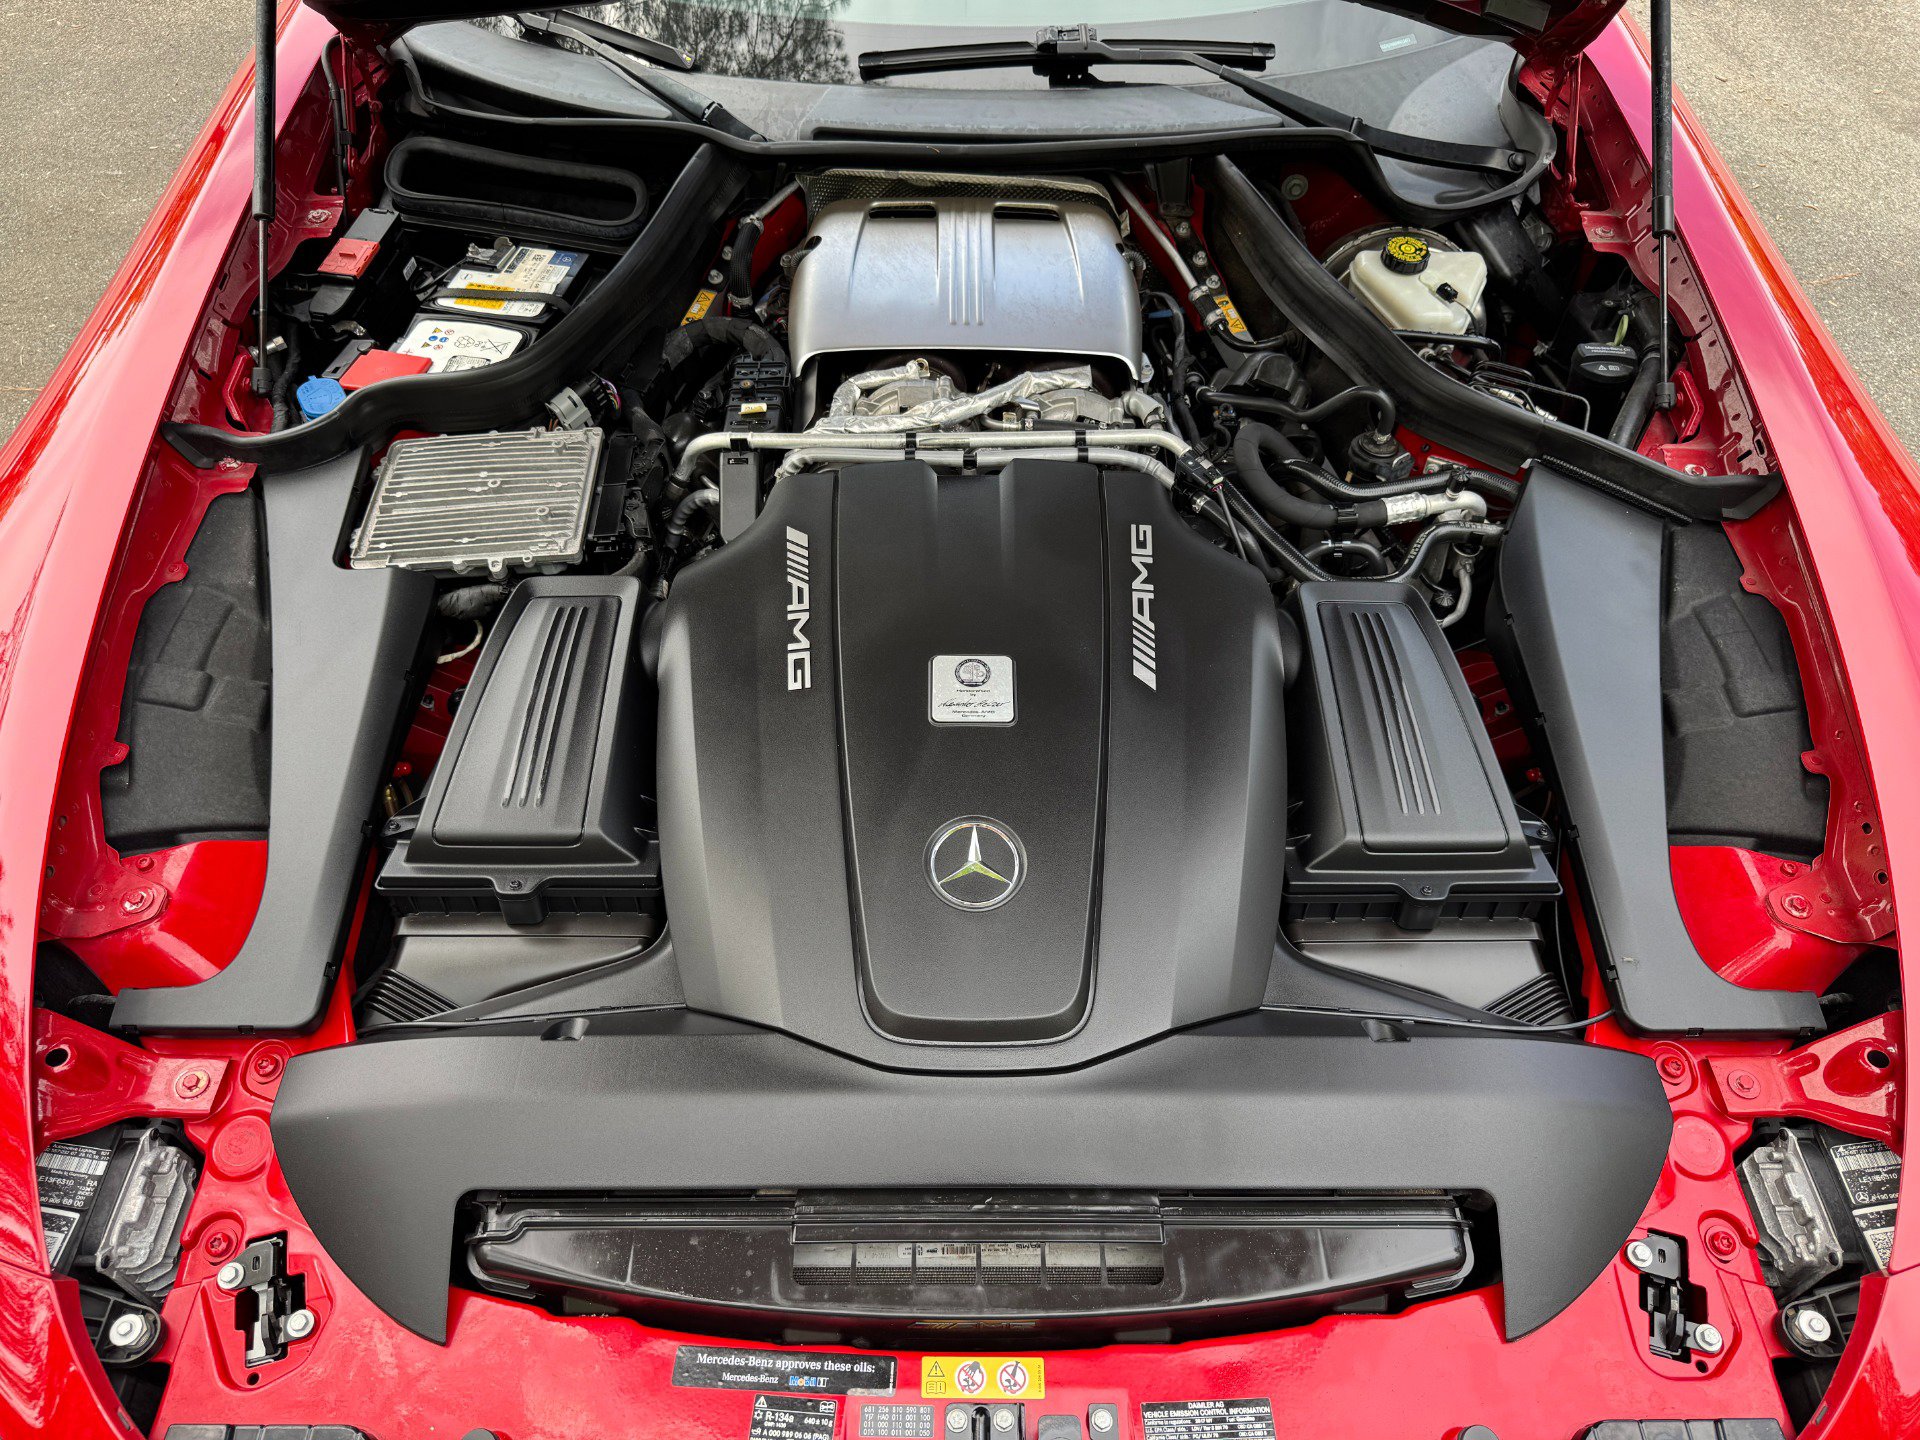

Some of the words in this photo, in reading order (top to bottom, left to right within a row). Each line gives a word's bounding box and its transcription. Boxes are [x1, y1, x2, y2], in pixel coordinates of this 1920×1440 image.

[1131, 524, 1155, 630] AMG
[787, 576, 811, 691] AMG
[697, 1353, 774, 1368] Mercedes-Benz
[775, 1359, 822, 1372] approves
[824, 1358, 852, 1372] these
[853, 1361, 876, 1373] oils:
[722, 1372, 779, 1384] Mercedes-Benz
[789, 1376, 817, 1387] Mobil
[766, 1411, 795, 1423] R-134a
[1143, 1411, 1169, 1419] VEHICLE
[1170, 1410, 1200, 1418] EMISSION
[1229, 1407, 1271, 1416] INFORMATION
